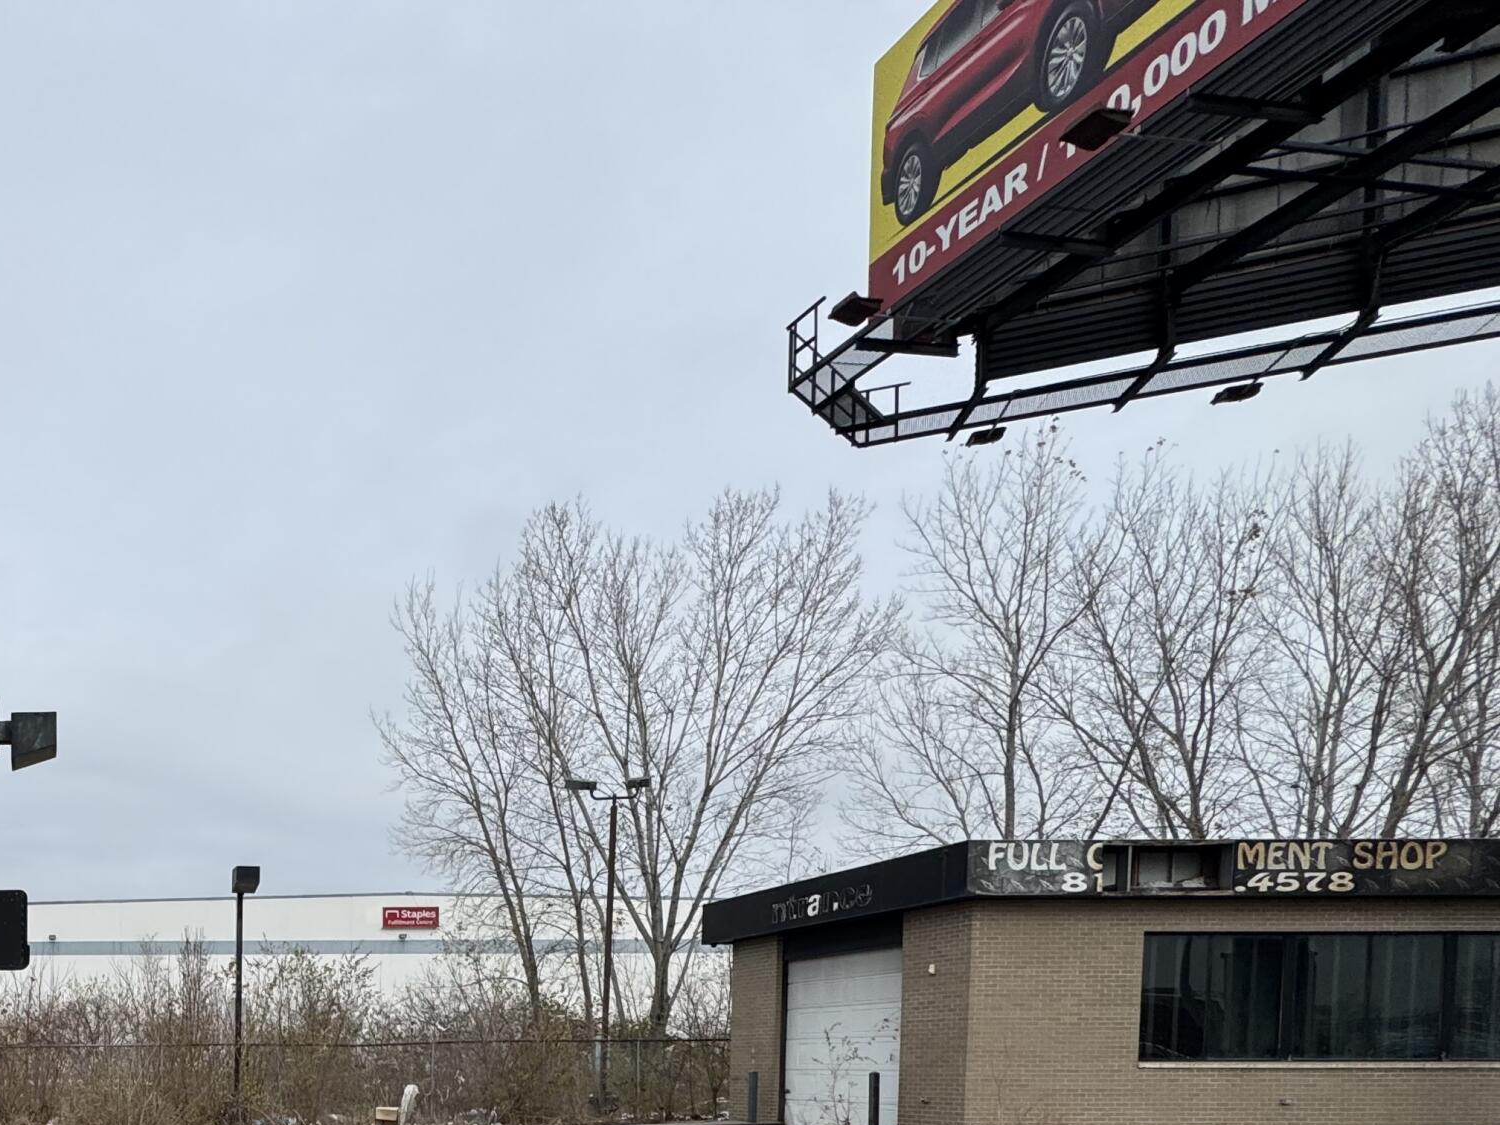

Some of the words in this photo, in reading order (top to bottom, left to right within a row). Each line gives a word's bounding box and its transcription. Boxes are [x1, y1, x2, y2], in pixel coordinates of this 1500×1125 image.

[892, 162, 1029, 285] 10-YEAR
[988, 842, 1067, 871] FULL
[1352, 841, 1448, 870] SHOP
[401, 909, 436, 921] Staples
